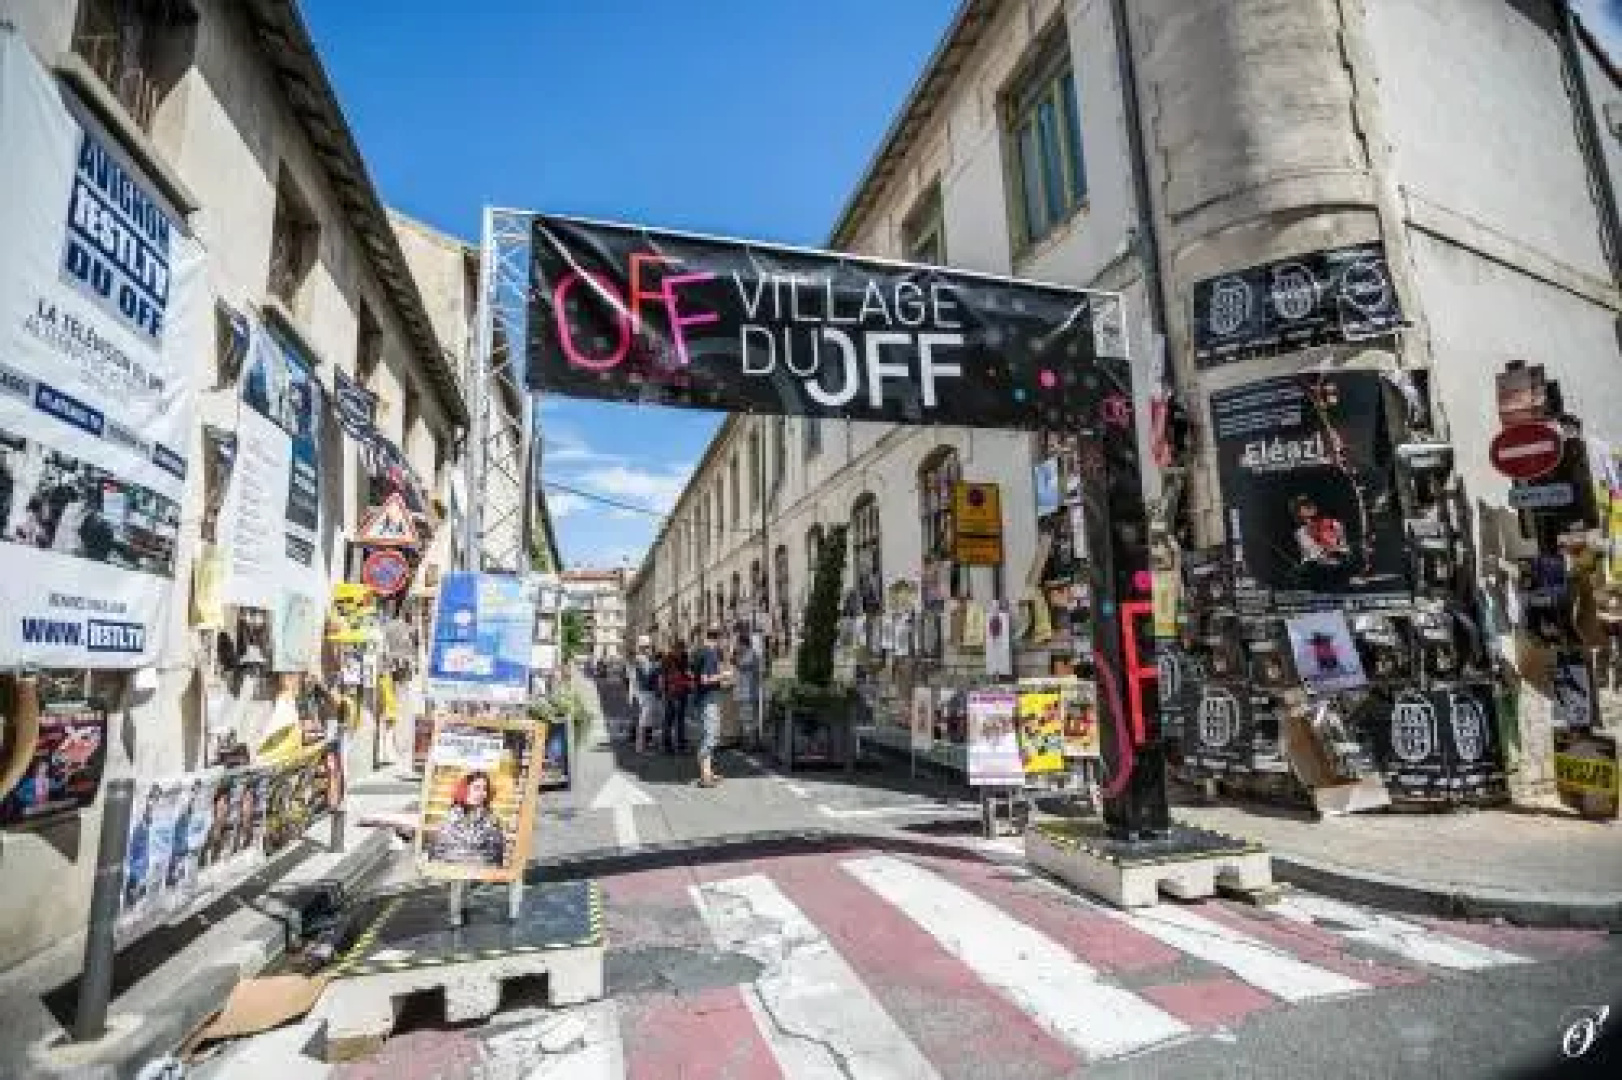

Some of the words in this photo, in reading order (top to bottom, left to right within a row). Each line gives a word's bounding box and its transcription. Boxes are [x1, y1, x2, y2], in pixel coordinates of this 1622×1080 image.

[78, 133, 170, 255] AVIGNON
[67, 239, 111, 298] DU
[119, 284, 163, 337] OFF
[553, 250, 720, 370] OFF
[732, 269, 962, 330] VILLAGE
[740, 326, 817, 377] DU
